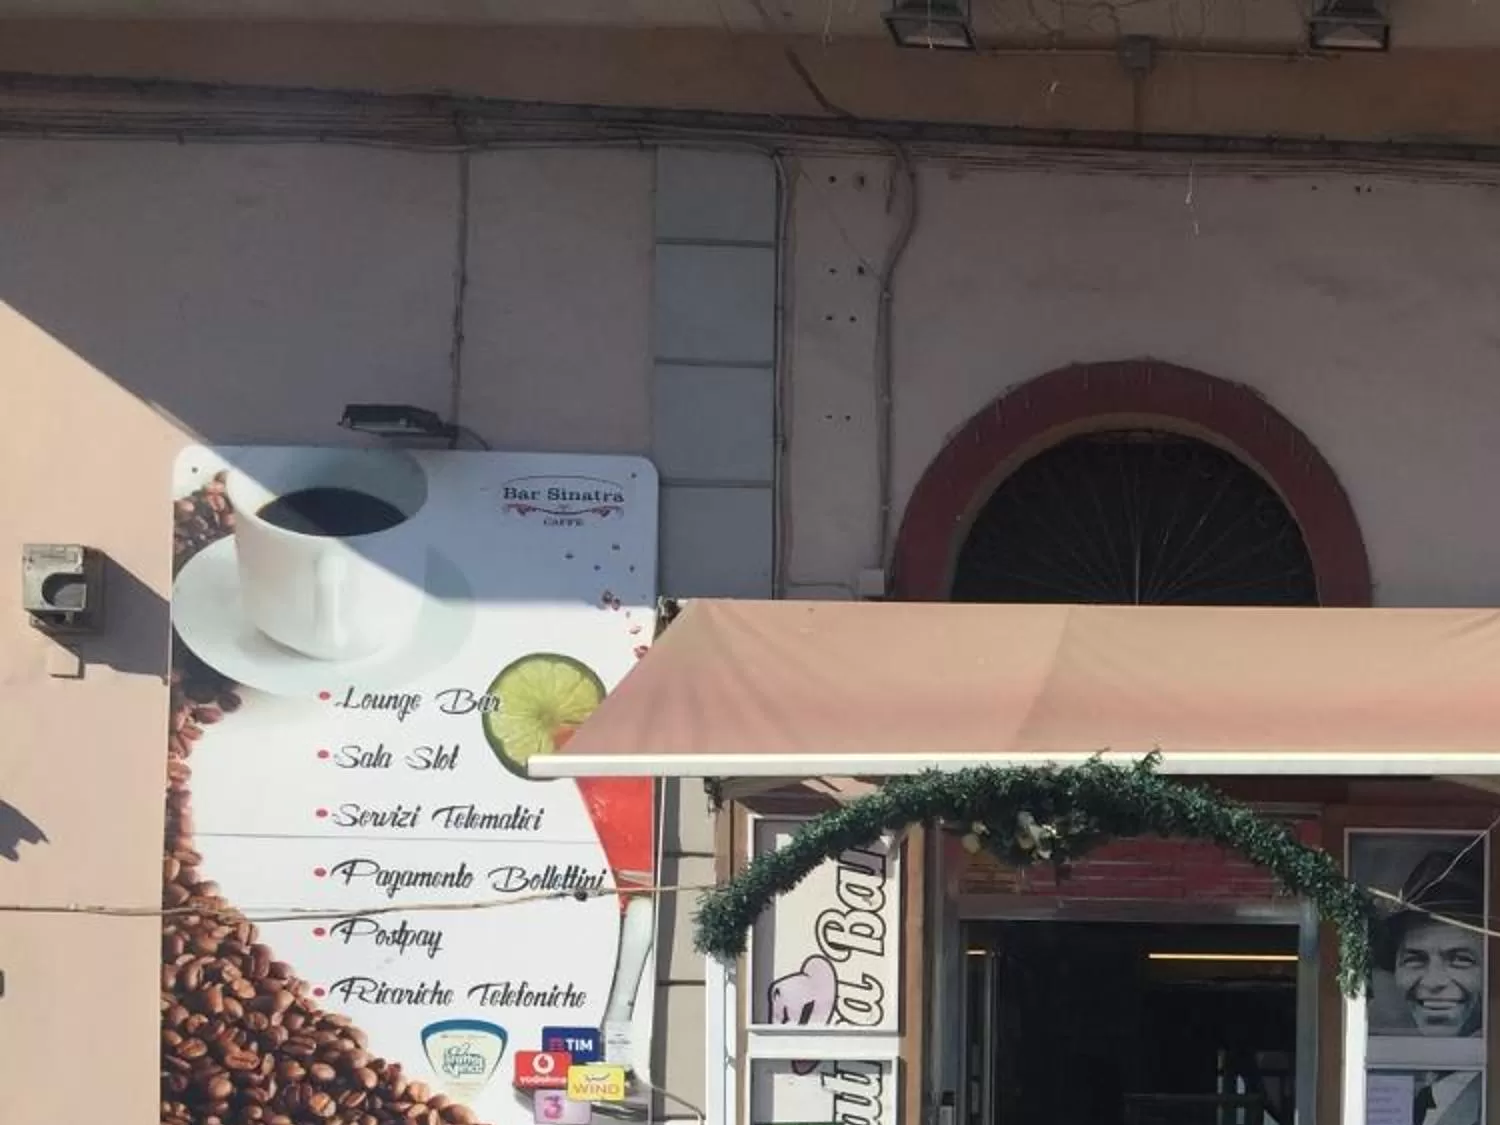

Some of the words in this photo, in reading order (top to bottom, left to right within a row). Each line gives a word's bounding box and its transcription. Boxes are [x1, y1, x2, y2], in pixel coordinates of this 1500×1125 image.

[503, 487, 541, 500] Bar
[547, 487, 625, 502] Sinatra
[334, 685, 422, 722] Lounge
[435, 688, 501, 715] Bar
[335, 744, 393, 770] Sala
[404, 744, 460, 771] Slot
[332, 803, 421, 829] Servizi
[431, 805, 545, 831] Telematici
[330, 858, 474, 899] Pagamento
[487, 864, 607, 893] Bollettini
[329, 917, 444, 959] Postpay
[329, 976, 455, 1006] Ricariche
[468, 980, 587, 1009] Telefoniche
[566, 1038, 593, 1051] TIM
[575, 1082, 619, 1096] WIND
[544, 1095, 563, 1120] 3
